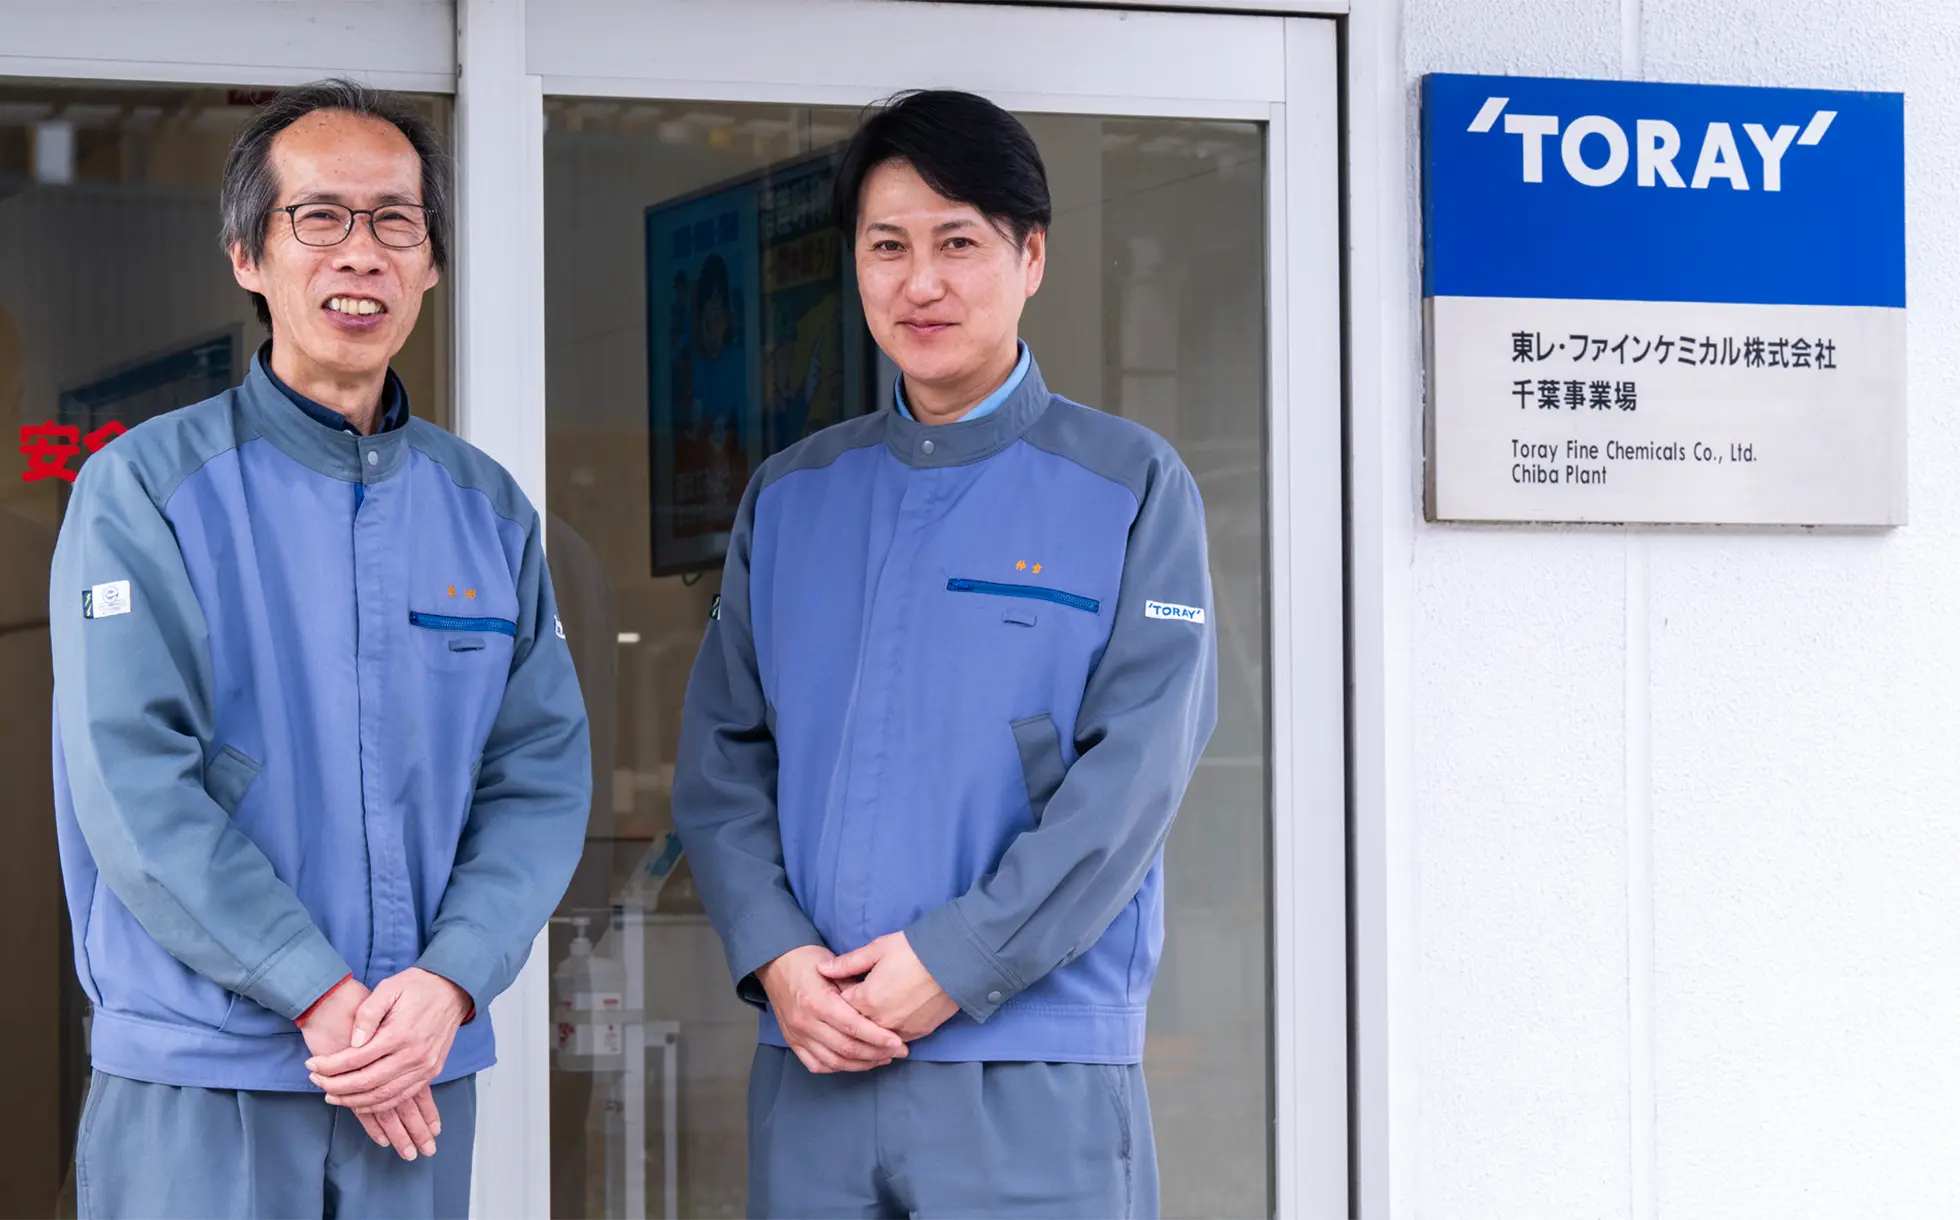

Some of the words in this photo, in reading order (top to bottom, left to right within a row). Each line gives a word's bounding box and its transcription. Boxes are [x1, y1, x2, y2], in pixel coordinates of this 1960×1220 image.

[1511, 331, 1837, 370] 東レ・ファインケミカル株式会社
[1511, 379, 1638, 412] 千葉事業場
[1511, 439, 1558, 463] Toray
[1566, 440, 1599, 460] Fine
[1606, 440, 1686, 462] Chemicals
[1693, 442, 1723, 464] Co.,
[1730, 443, 1757, 462] Ltd.
[1511, 463, 1559, 484] Chiba
[1566, 465, 1607, 485] Plant
